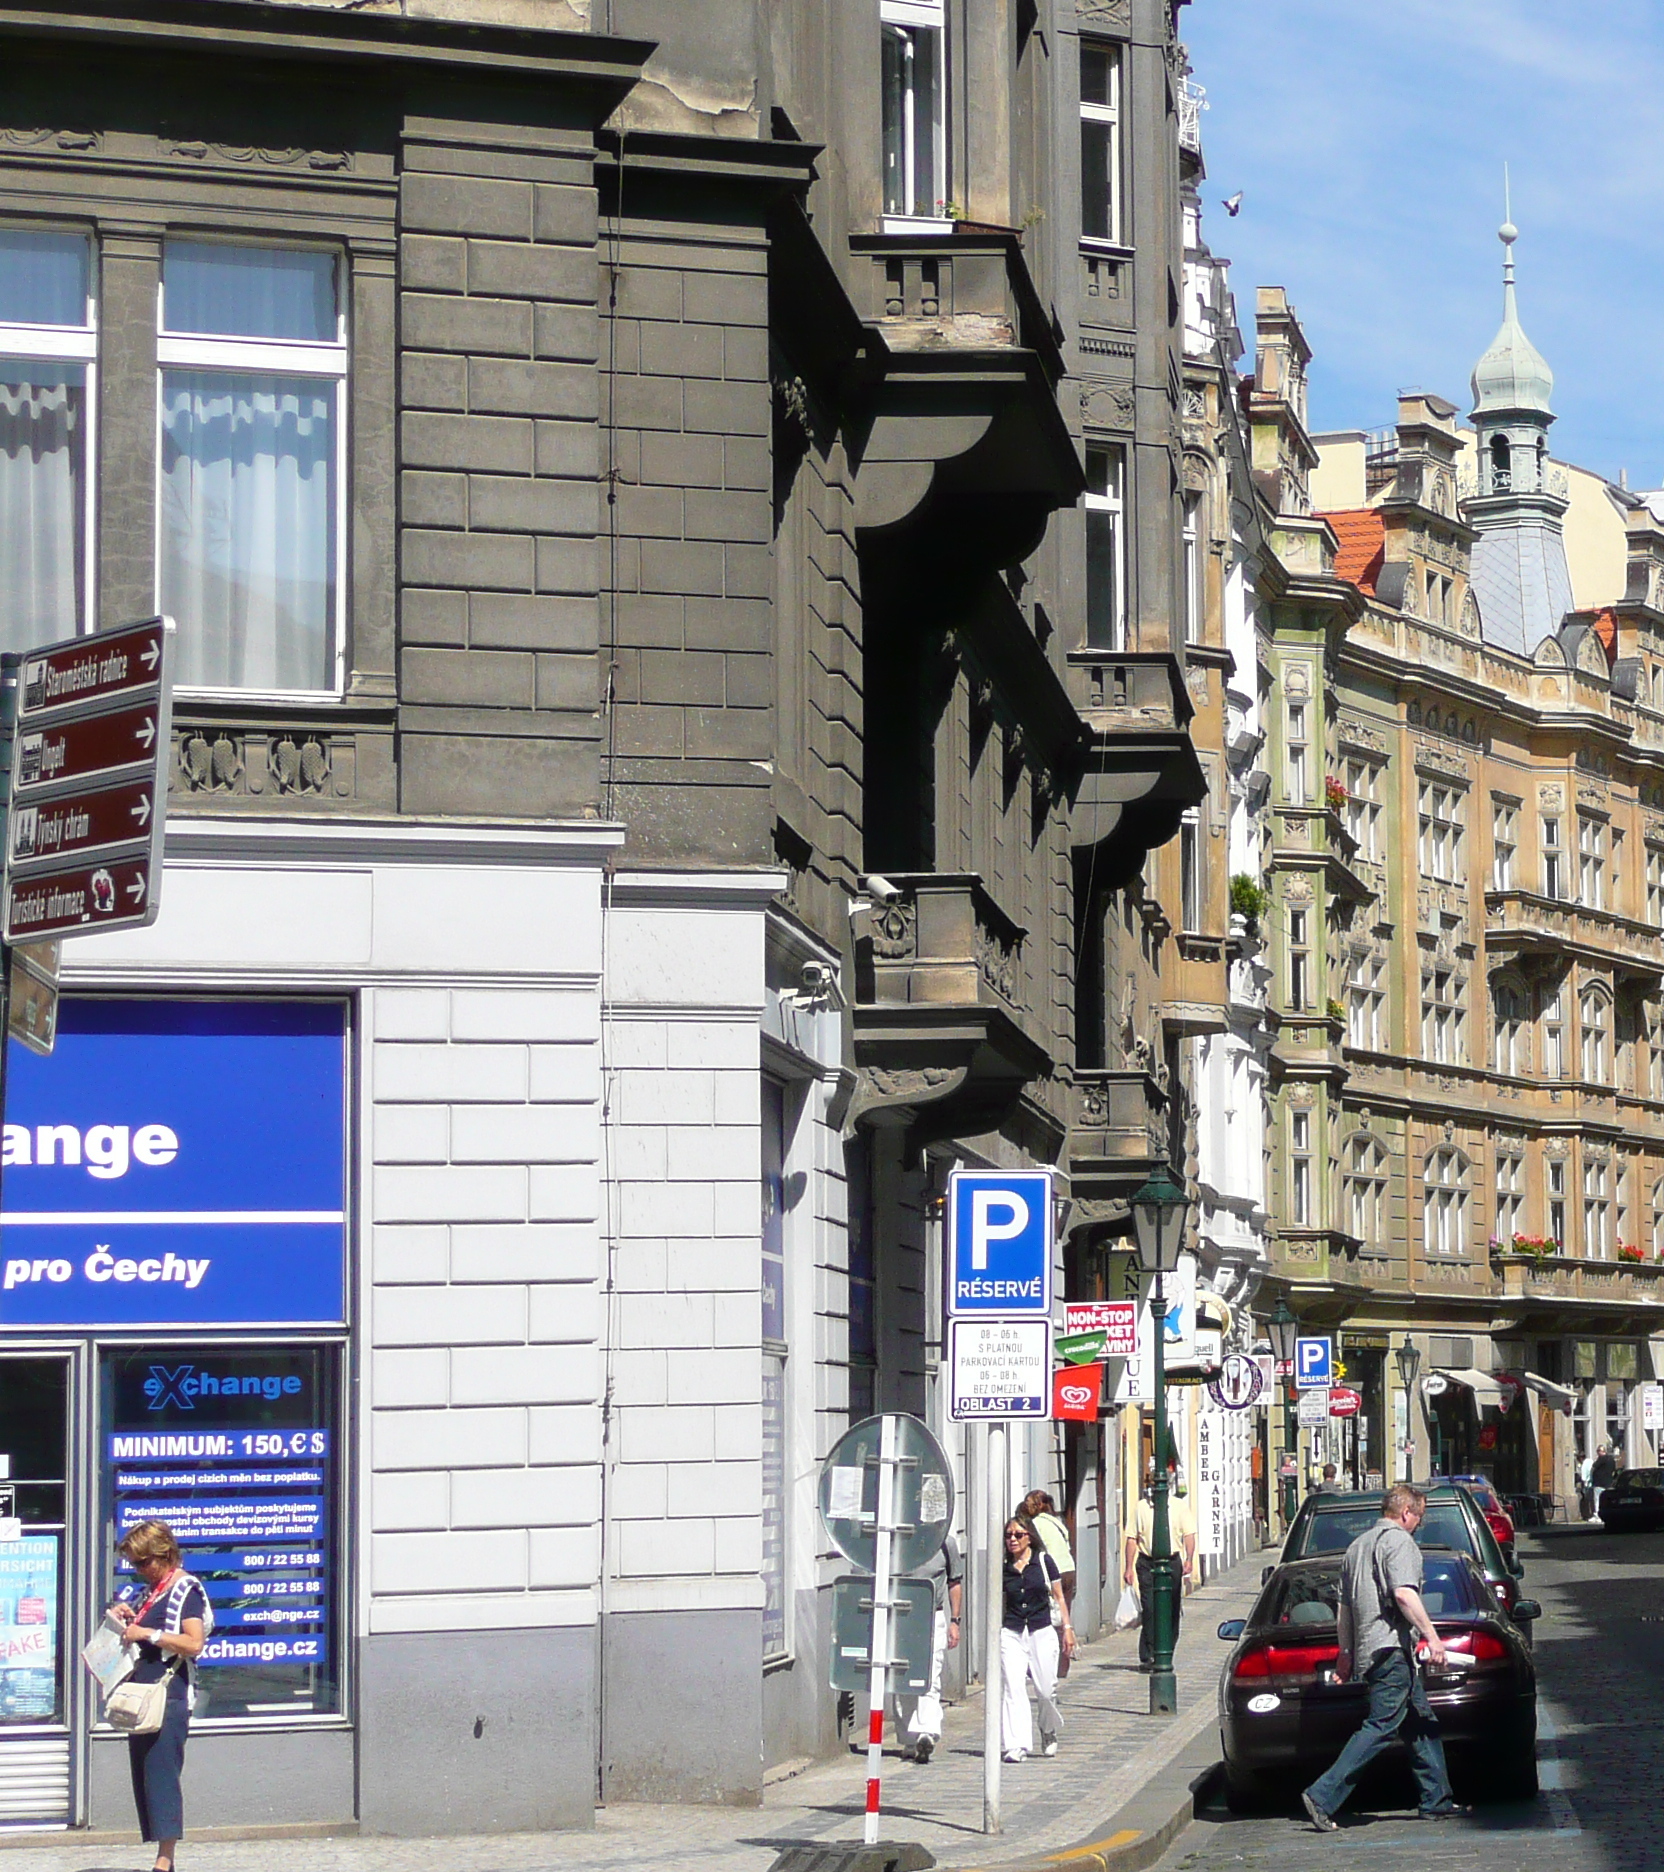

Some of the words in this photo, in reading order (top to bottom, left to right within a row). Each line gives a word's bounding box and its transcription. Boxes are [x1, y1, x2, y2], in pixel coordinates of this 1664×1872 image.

[971, 1190, 1029, 1270] P
[3, 1257, 73, 1290] pro
[84, 1244, 211, 1290] Čechy
[957, 1276, 1042, 1298] RÉSERVÉ
[1067, 1310, 1133, 1325] NON-STOP
[986, 1343, 1022, 1353] PLATNOU
[960, 1355, 1006, 1366] PARKOVACÍ
[1008, 1356, 1040, 1366] KARTOU
[1303, 1343, 1324, 1373] P
[973, 1384, 989, 1394] BEZ
[991, 1382, 1026, 1394] OMEZENÍ
[960, 1398, 1014, 1411] OBLAST
[1022, 1398, 1031, 1410] 2
[113, 1436, 234, 1457] MINIMUM:
[1199, 1418, 1210, 1482] AMBER
[119, 1474, 152, 1487] Nákup
[163, 1474, 196, 1486] prodej
[230, 1473, 251, 1483] měn
[254, 1473, 272, 1482] bez
[274, 1472, 321, 1485] poplatku.
[125, 1506, 201, 1518] Podnikatelským
[203, 1504, 253, 1516] subjektům
[256, 1503, 317, 1515] poskytujeme
[1211, 1470, 1221, 1548] GARNET
[193, 1515, 234, 1527] obchody
[236, 1514, 290, 1526] devizovými
[292, 1513, 320, 1525] kursy
[202, 1526, 248, 1536] transakce
[251, 1525, 263, 1535] do
[265, 1525, 283, 1536] pěti
[285, 1524, 314, 1534] minut
[244, 1555, 265, 1566] 800
[273, 1554, 288, 1565] 22
[290, 1554, 304, 1564] 55
[306, 1553, 320, 1564] 88
[244, 1584, 265, 1595] 800
[273, 1583, 288, 1594] 22
[290, 1583, 304, 1593] 55
[306, 1582, 320, 1593] 88
[243, 1609, 320, 1622] exch@nge.cz
[1254, 1697, 1273, 1709] CZ
